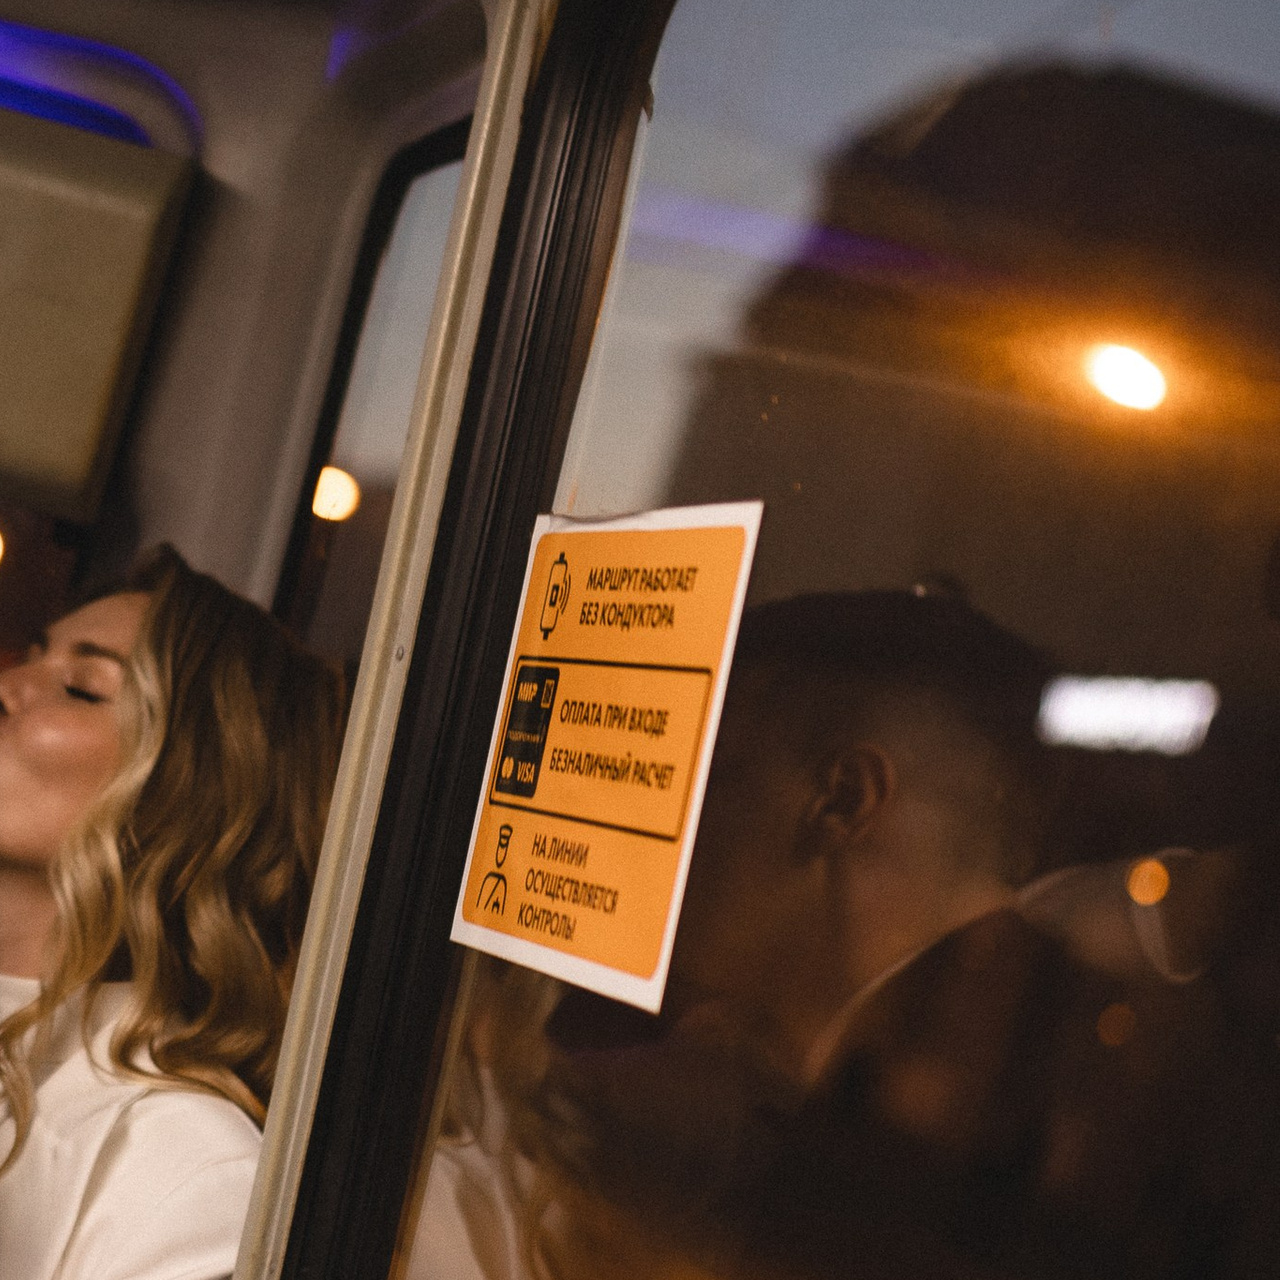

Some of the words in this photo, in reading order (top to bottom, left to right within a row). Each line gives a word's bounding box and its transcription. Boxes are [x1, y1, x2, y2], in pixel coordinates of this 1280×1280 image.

[586, 566, 640, 592] МАРШРУТ
[639, 566, 698, 592] РАБОТАЕТ
[579, 602, 600, 626] БЕЗ
[600, 602, 675, 632] КОНДУКТОРА
[560, 699, 602, 727] ОПЛАТА
[603, 703, 628, 730] ПРИ
[628, 706, 668, 738] ВХОДЕ
[517, 761, 536, 784] VISA
[549, 747, 632, 784] БЕЗНАЛИЧНЫЙ
[631, 760, 674, 790] РАСЧЕТ
[531, 833, 547, 860] НА
[547, 836, 589, 869] ЛИНИИ
[525, 868, 619, 915] ОСУЩЕСТВЛЯЕТСЯ
